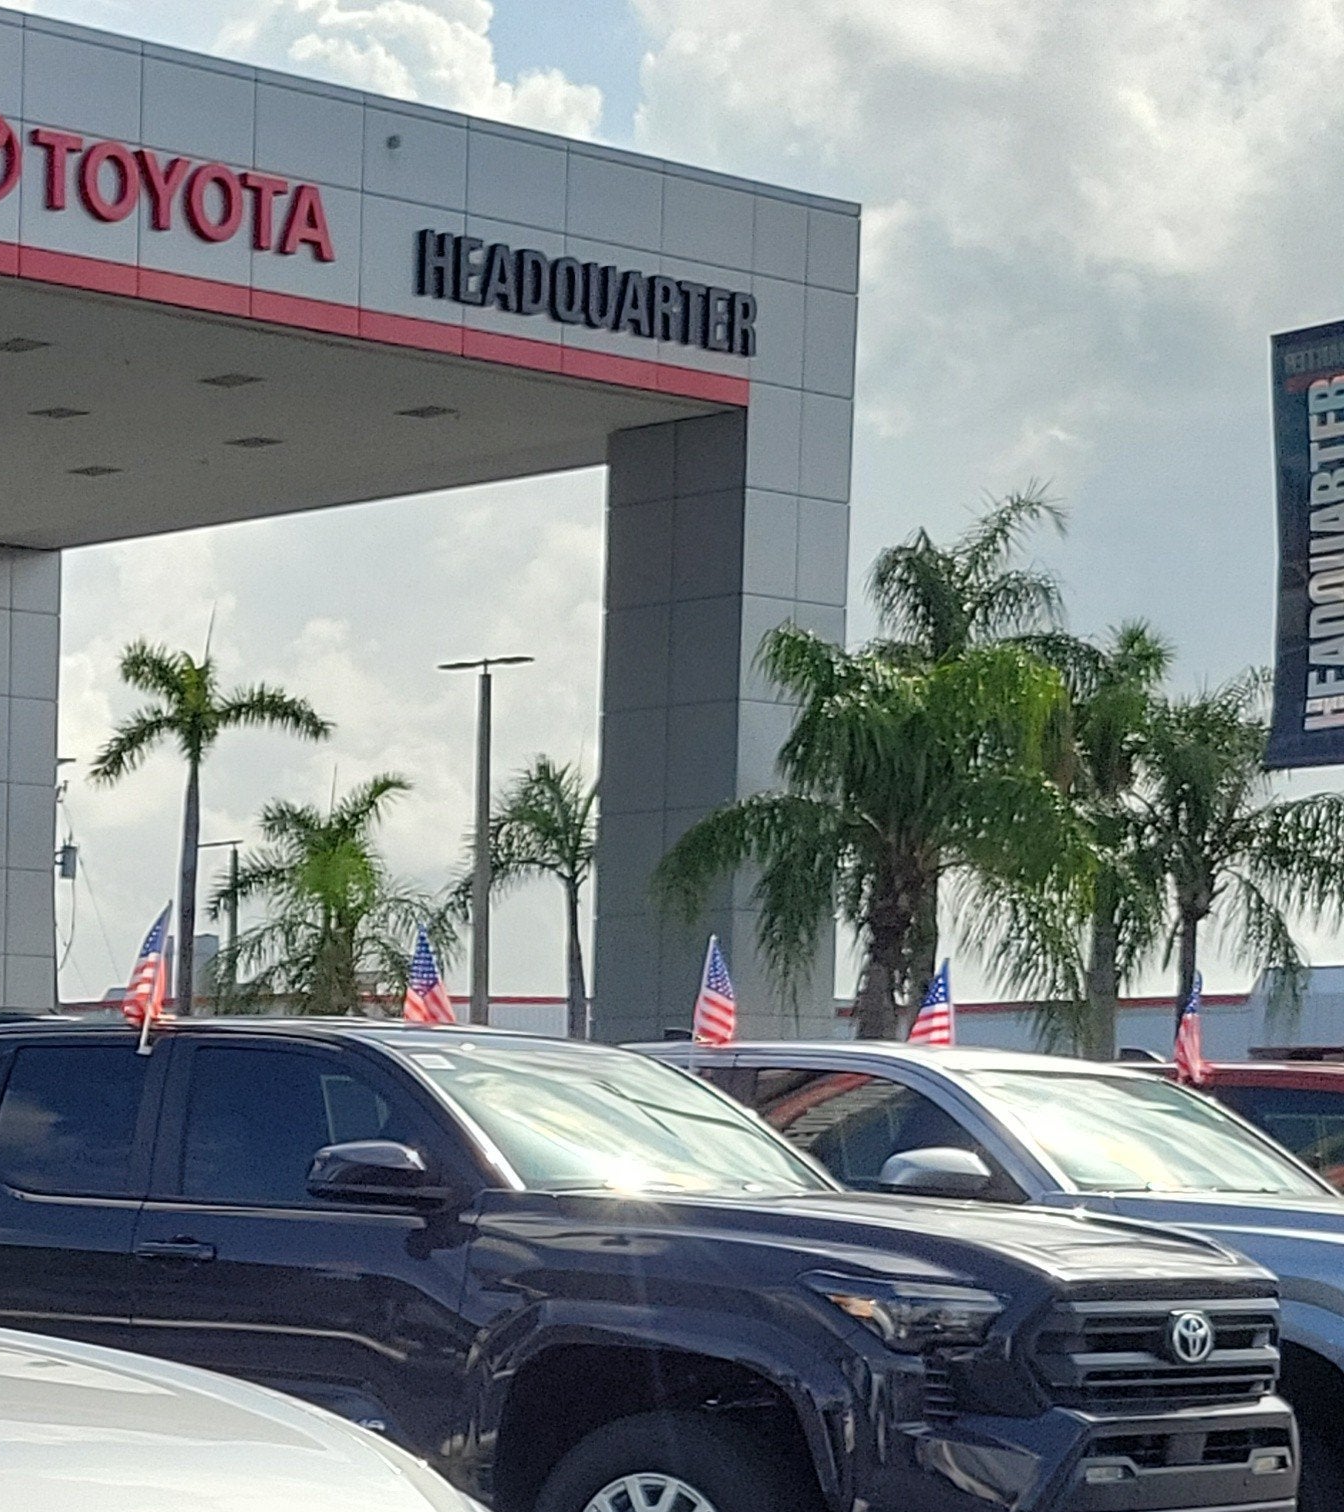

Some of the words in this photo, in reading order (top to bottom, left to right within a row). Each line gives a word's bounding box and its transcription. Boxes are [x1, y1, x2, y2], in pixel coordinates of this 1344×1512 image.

[30, 127, 336, 263] TOYOTA
[412, 228, 759, 356] HEADQUARTER
[1303, 373, 1344, 732] HEADQUARTER
